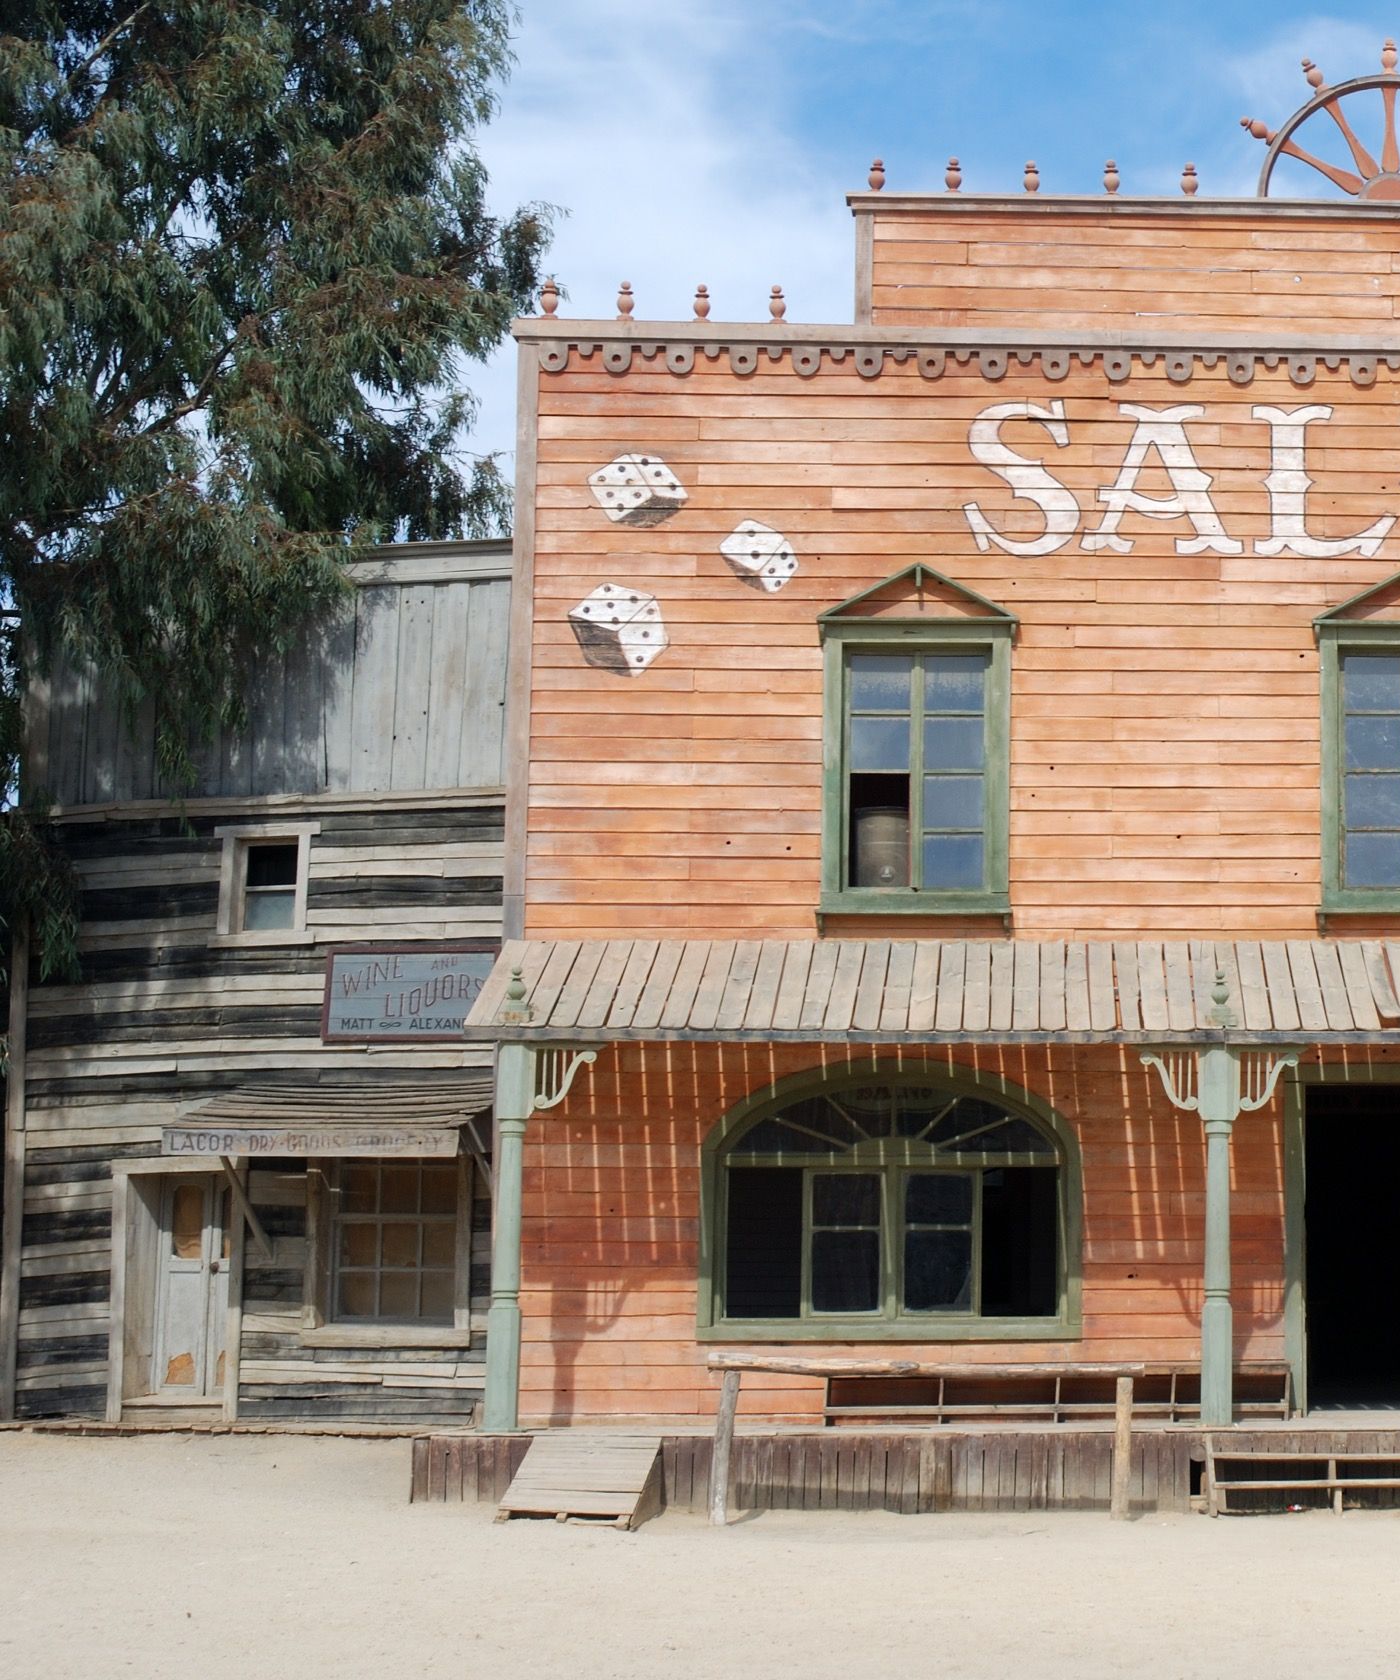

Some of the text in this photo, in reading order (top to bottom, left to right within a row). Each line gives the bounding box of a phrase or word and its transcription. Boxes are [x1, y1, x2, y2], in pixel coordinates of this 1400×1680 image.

[342, 955, 458, 996] WINE AND
[341, 1017, 375, 1030] MATT
[170, 1134, 233, 1151] LACOR
